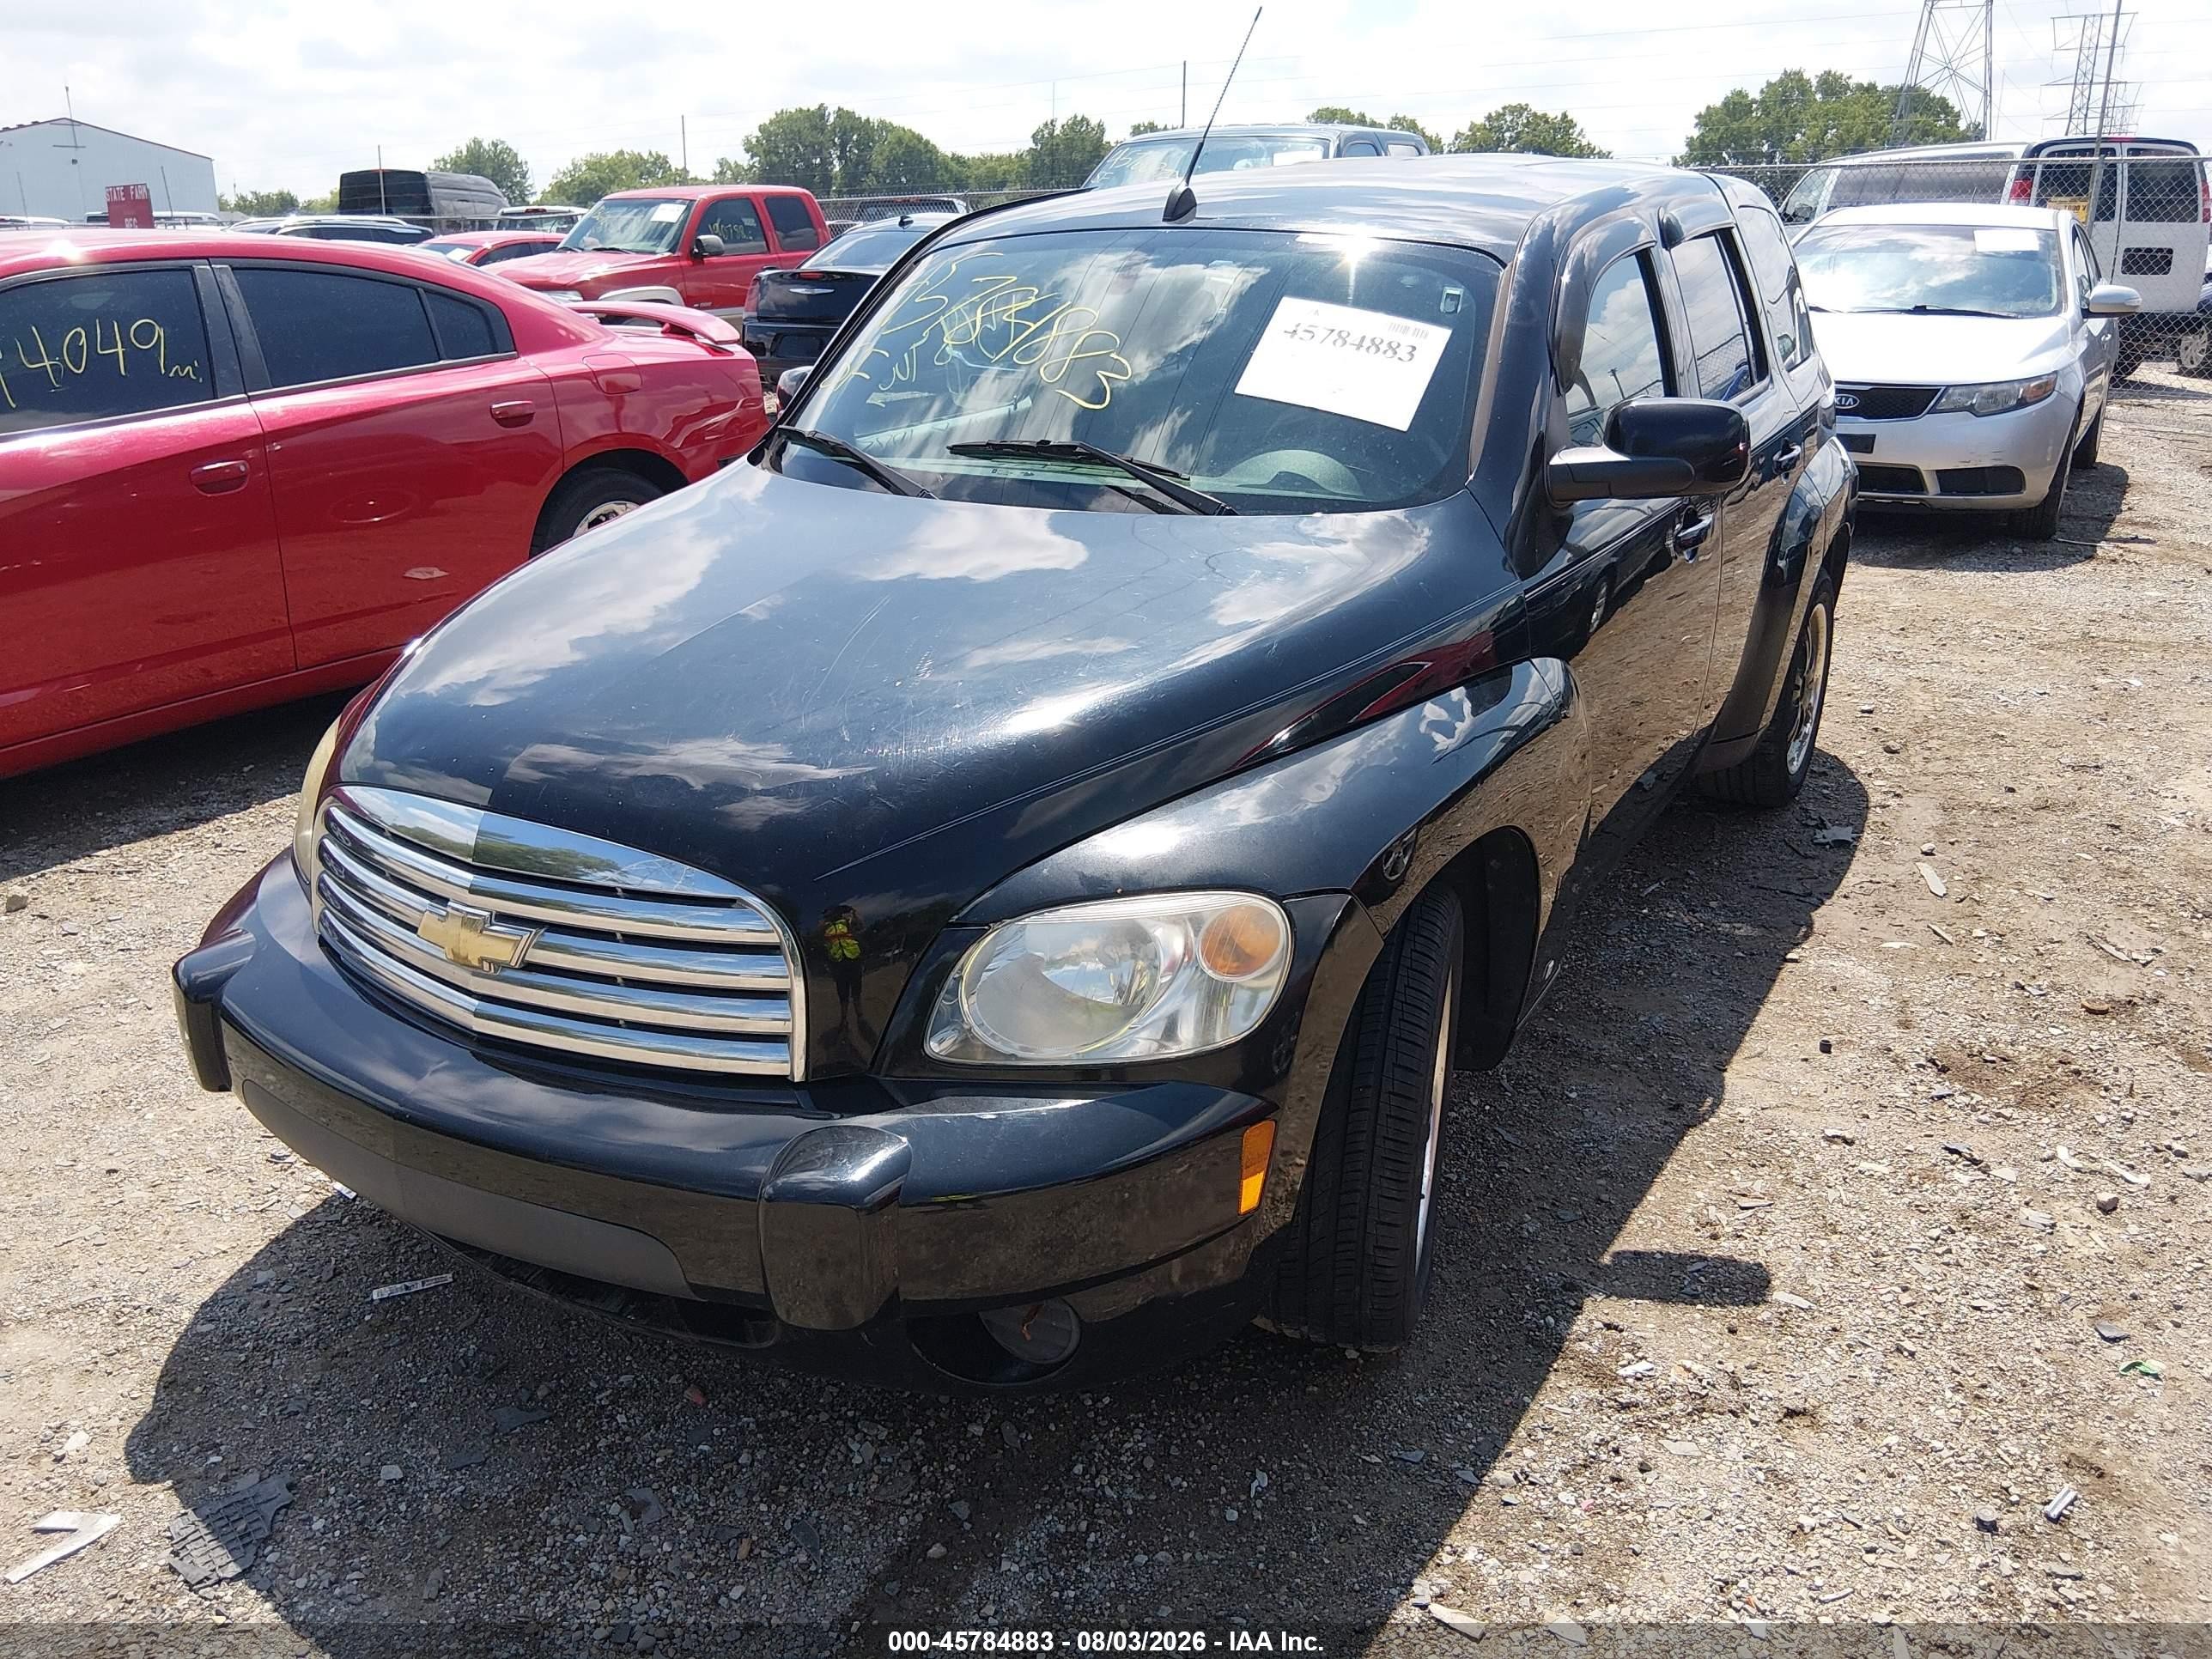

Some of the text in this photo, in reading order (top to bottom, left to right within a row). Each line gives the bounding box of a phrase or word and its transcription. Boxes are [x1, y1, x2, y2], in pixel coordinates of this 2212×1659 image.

[106, 185, 148, 203] STATE FARM
[1284, 322, 1418, 362] 45784883
[0, 318, 164, 408] 4049
[1834, 396, 1854, 406] KIA
